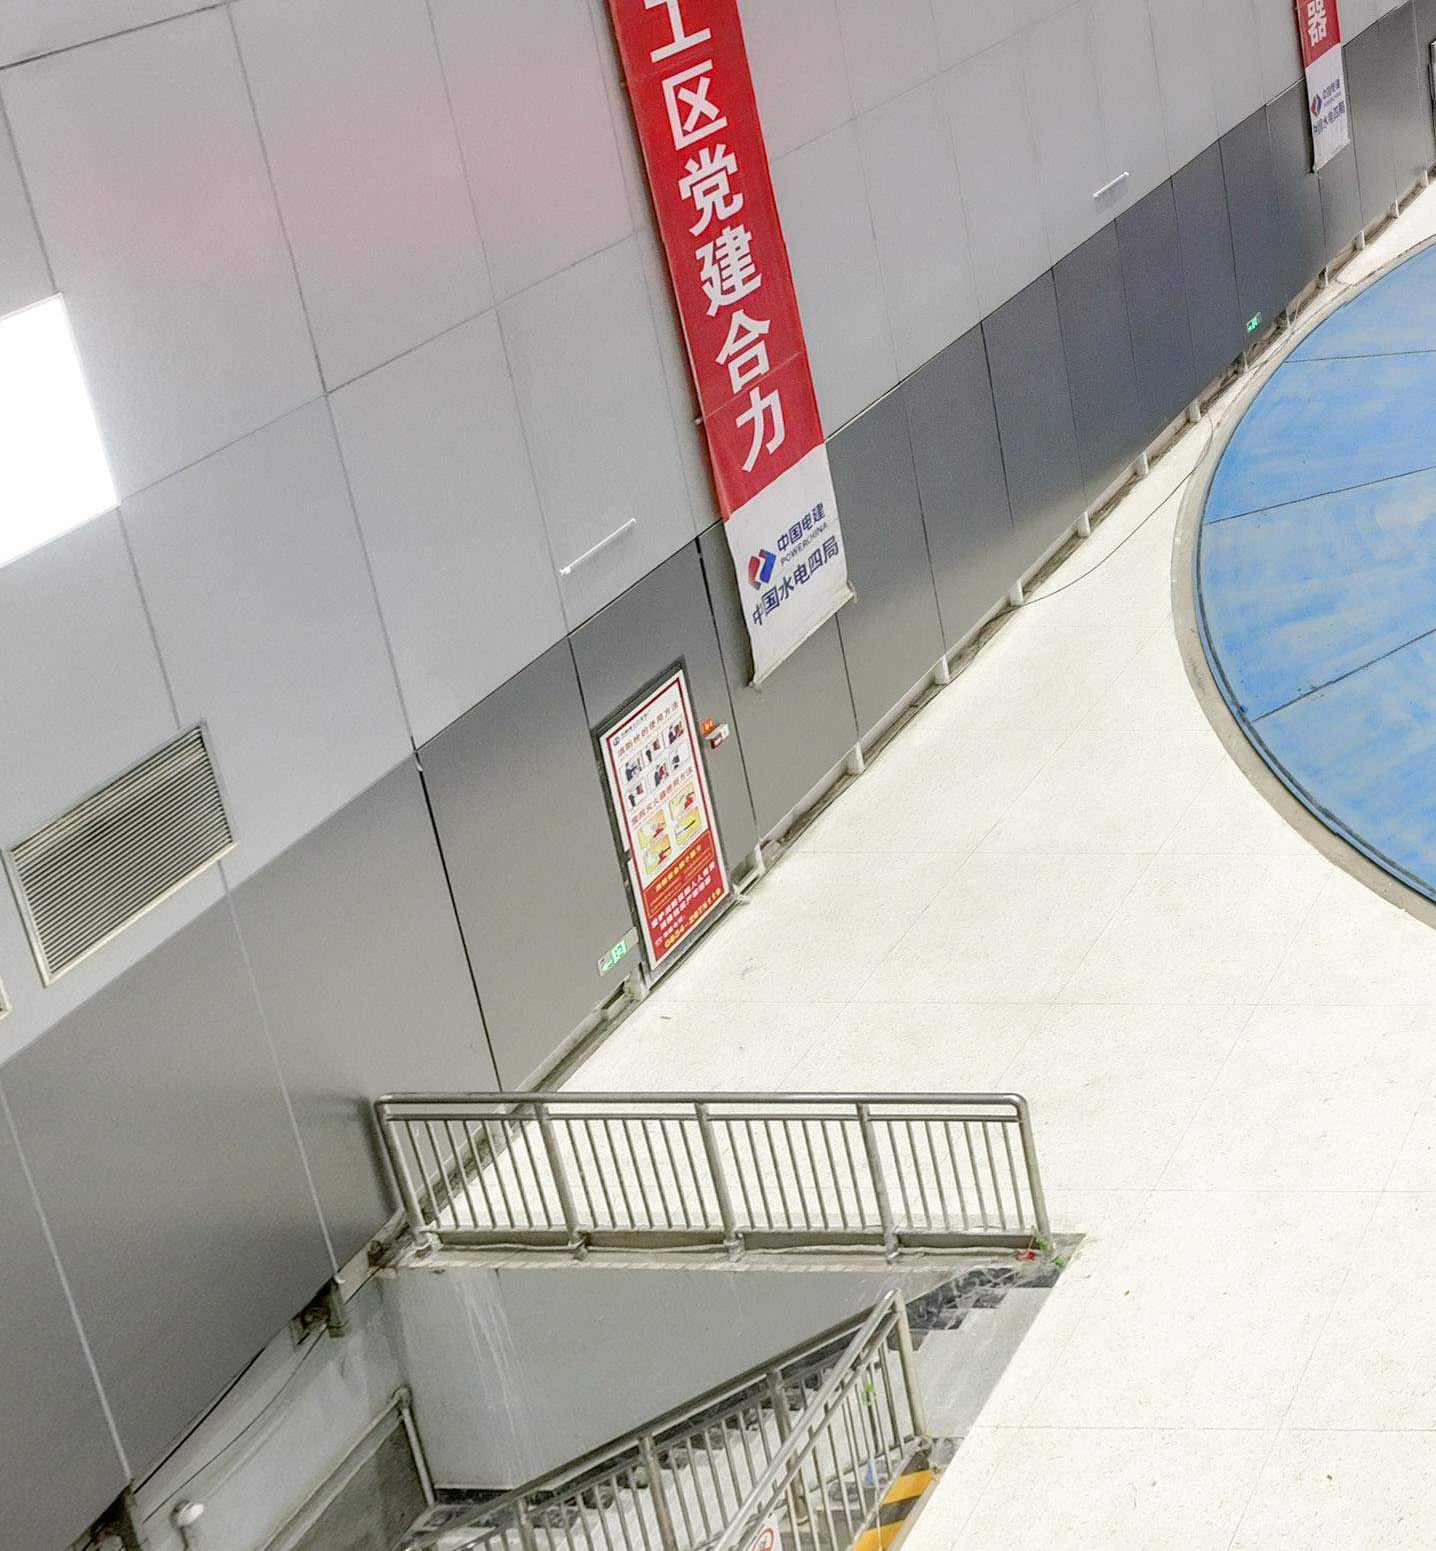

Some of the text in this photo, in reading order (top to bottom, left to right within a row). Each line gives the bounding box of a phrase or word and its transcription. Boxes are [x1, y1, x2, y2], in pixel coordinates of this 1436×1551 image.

[777, 502, 826, 552] 中国电建
[779, 522, 829, 566] POWERCHINA
[752, 535, 840, 626] 中国水电四局
